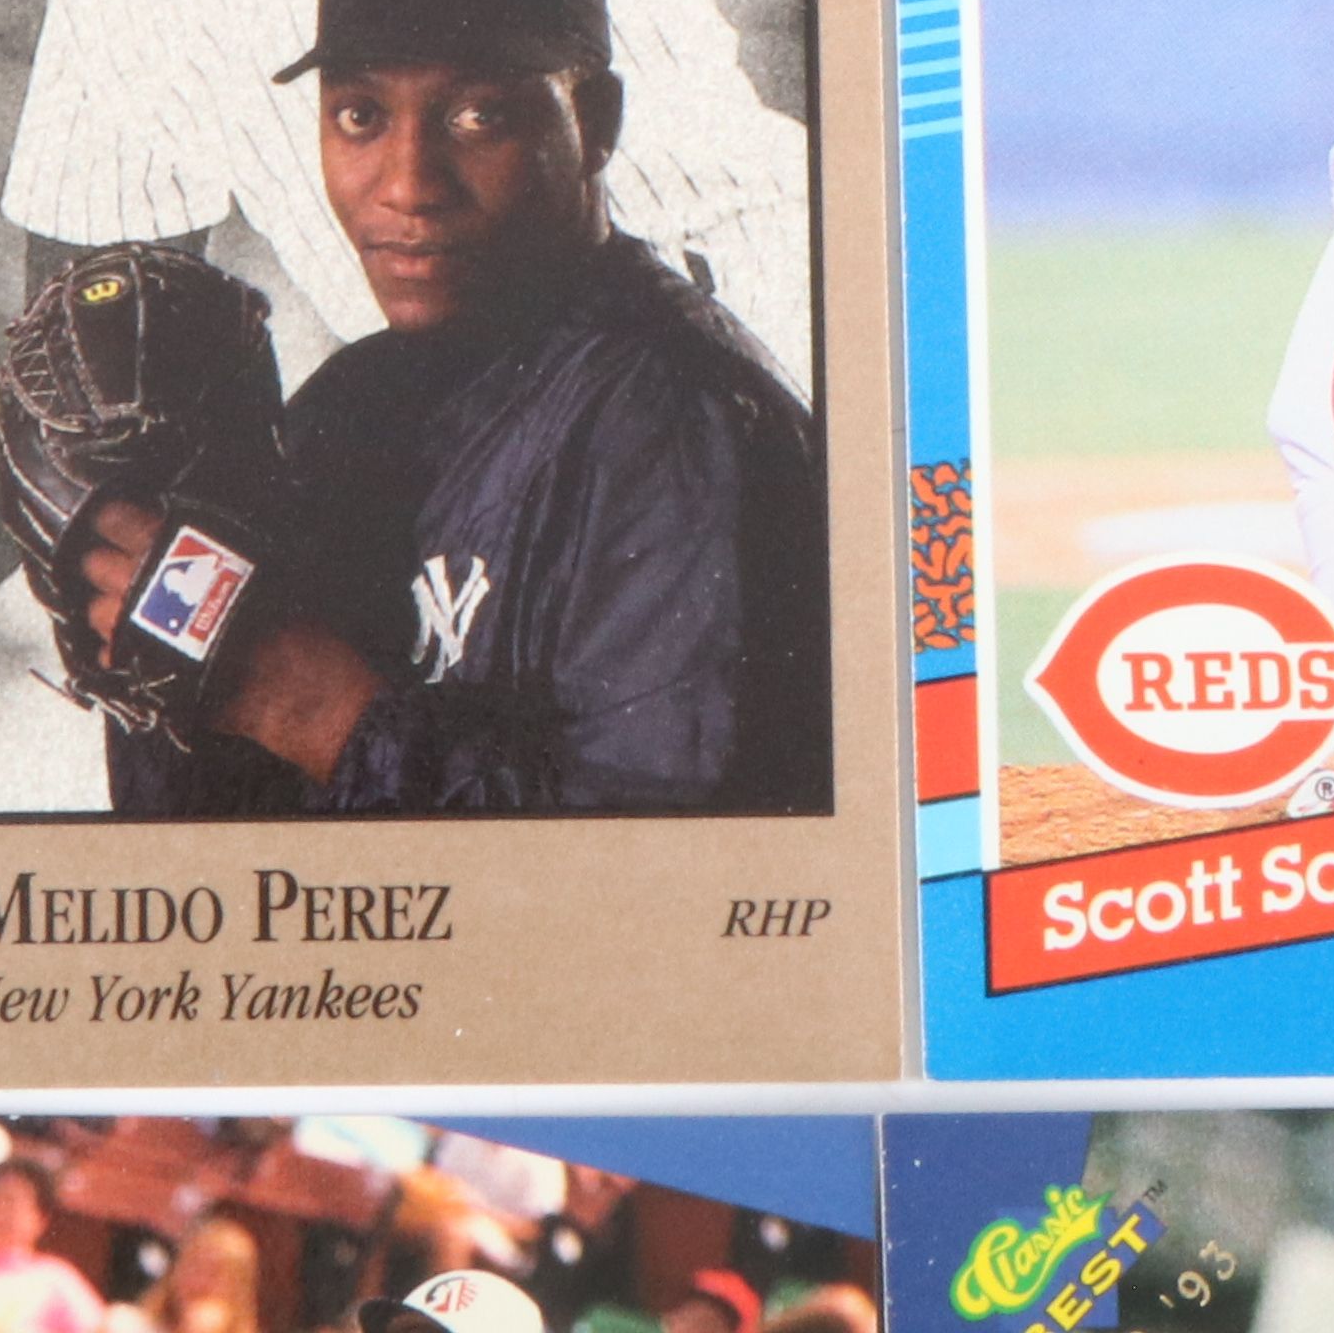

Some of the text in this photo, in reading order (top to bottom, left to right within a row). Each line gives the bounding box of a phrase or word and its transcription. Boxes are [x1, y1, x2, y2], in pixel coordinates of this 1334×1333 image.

[251, 868, 454, 943] PEREZ
[723, 896, 833, 940] RHP
[1041, 854, 1243, 954] Scott
[90, 971, 200, 1022] York
[221, 969, 422, 1022] Yankees
[952, 1186, 1113, 1319] Classic
[1022, 1213, 1148, 1333] EST
